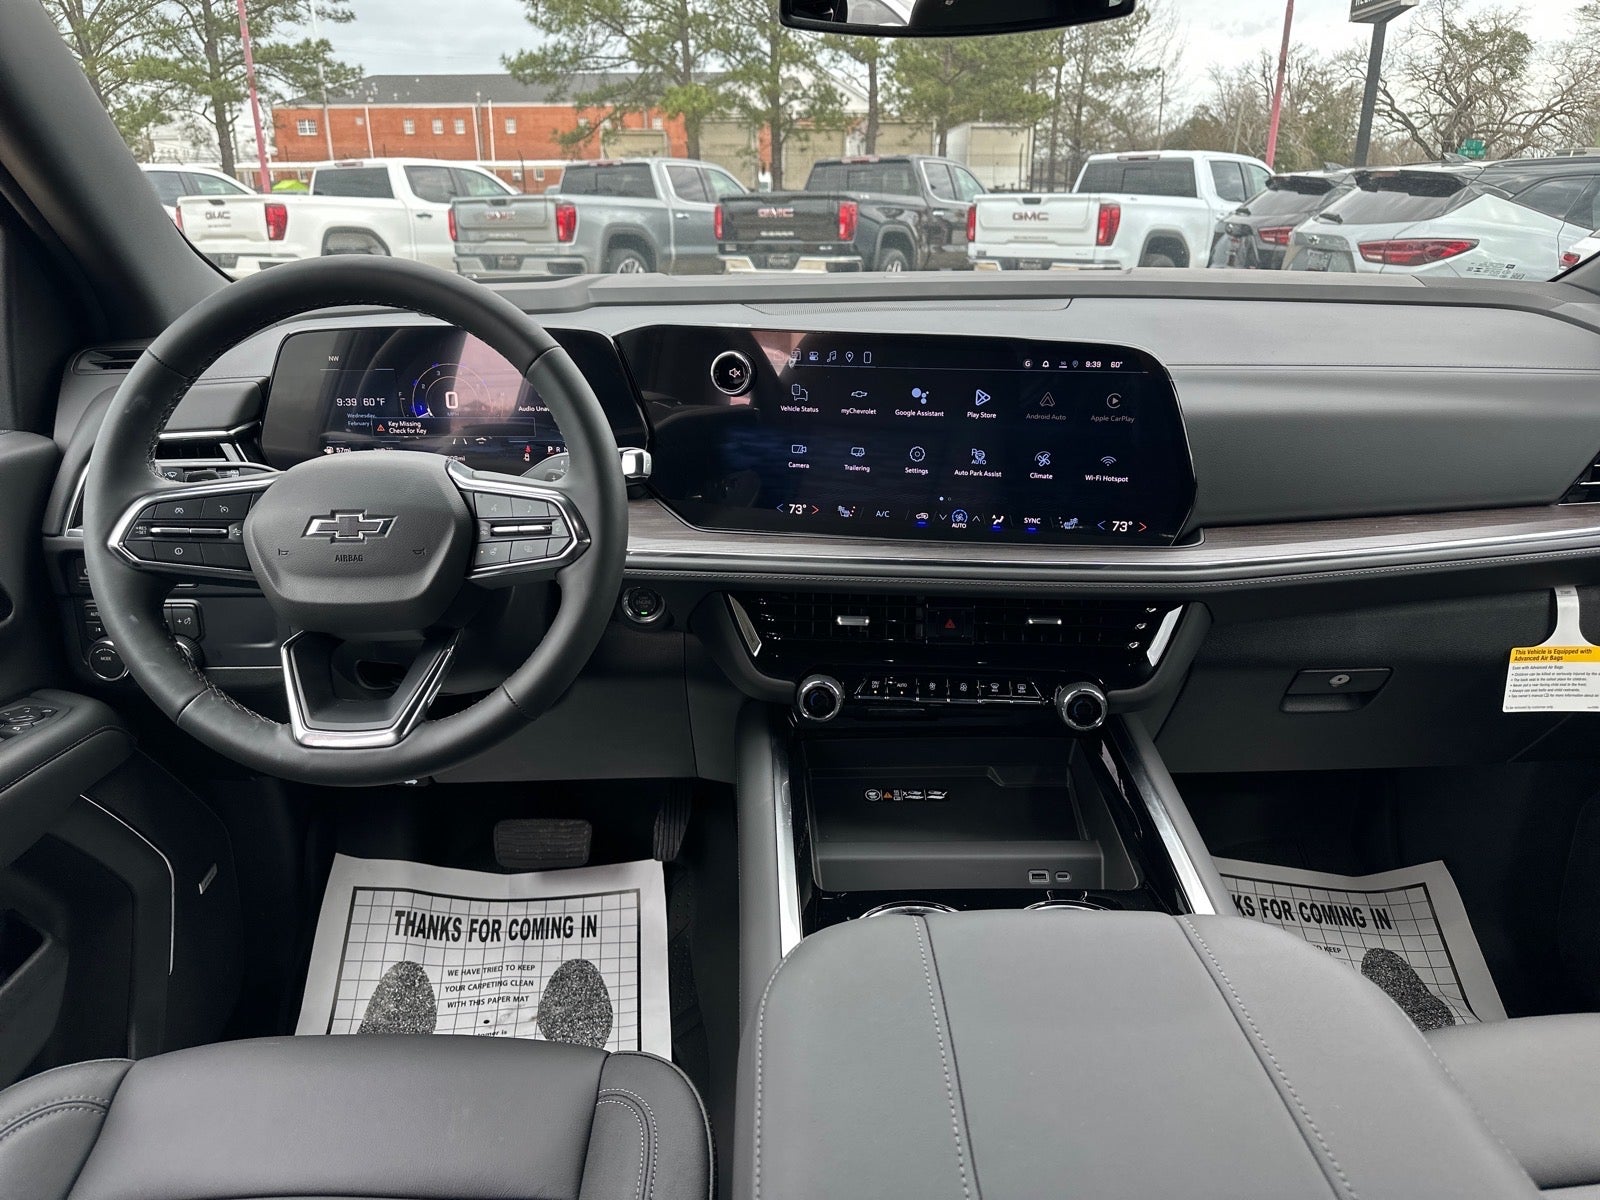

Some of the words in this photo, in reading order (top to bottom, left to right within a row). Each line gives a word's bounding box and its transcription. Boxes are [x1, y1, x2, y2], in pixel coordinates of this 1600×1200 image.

[205, 211, 231, 220] GMC
[758, 208, 794, 218] GMC
[1012, 212, 1049, 221] GMC
[336, 398, 358, 407] 9:39
[445, 391, 459, 409] 0
[780, 405, 800, 413] Vehicle
[800, 406, 819, 414] Status
[841, 408, 877, 416] myChevrolet
[895, 409, 916, 418] Google
[967, 411, 979, 420] Play
[1026, 413, 1050, 421] Android
[1091, 415, 1109, 423] Apple
[1109, 415, 1135, 424] CarPlay
[399, 421, 422, 429] Missing
[416, 428, 427, 436] Key
[844, 465, 871, 473] Trailering
[905, 467, 929, 476] Settings
[983, 470, 1002, 478] Assist
[1029, 472, 1053, 480] Climate
[1085, 474, 1102, 482] Wi-Fi
[1103, 475, 1129, 483] Hotspot
[788, 503, 807, 515] 73°
[875, 510, 890, 518] A/C
[1023, 517, 1041, 525] SYNC
[1112, 520, 1133, 532] 73°
[334, 554, 364, 562] AIRBAG
[1231, 894, 1256, 917] KS
[1259, 897, 1296, 922] FOR
[1299, 902, 1367, 929] COMING
[1369, 907, 1392, 930] IN
[395, 910, 462, 942] THANKS
[468, 918, 502, 942] FOR
[508, 915, 574, 941] COMING
[581, 914, 598, 938] IN
[447, 969, 459, 977] WE
[461, 967, 481, 976] HAVE
[483, 965, 503, 974] TRIED
[445, 984, 466, 993] YOUR
[467, 980, 508, 991] CARPETING
[510, 979, 534, 987] CLEAN
[447, 1000, 467, 1008] WITH
[469, 998, 485, 1007] THIS
[487, 996, 511, 1005] PAPER
